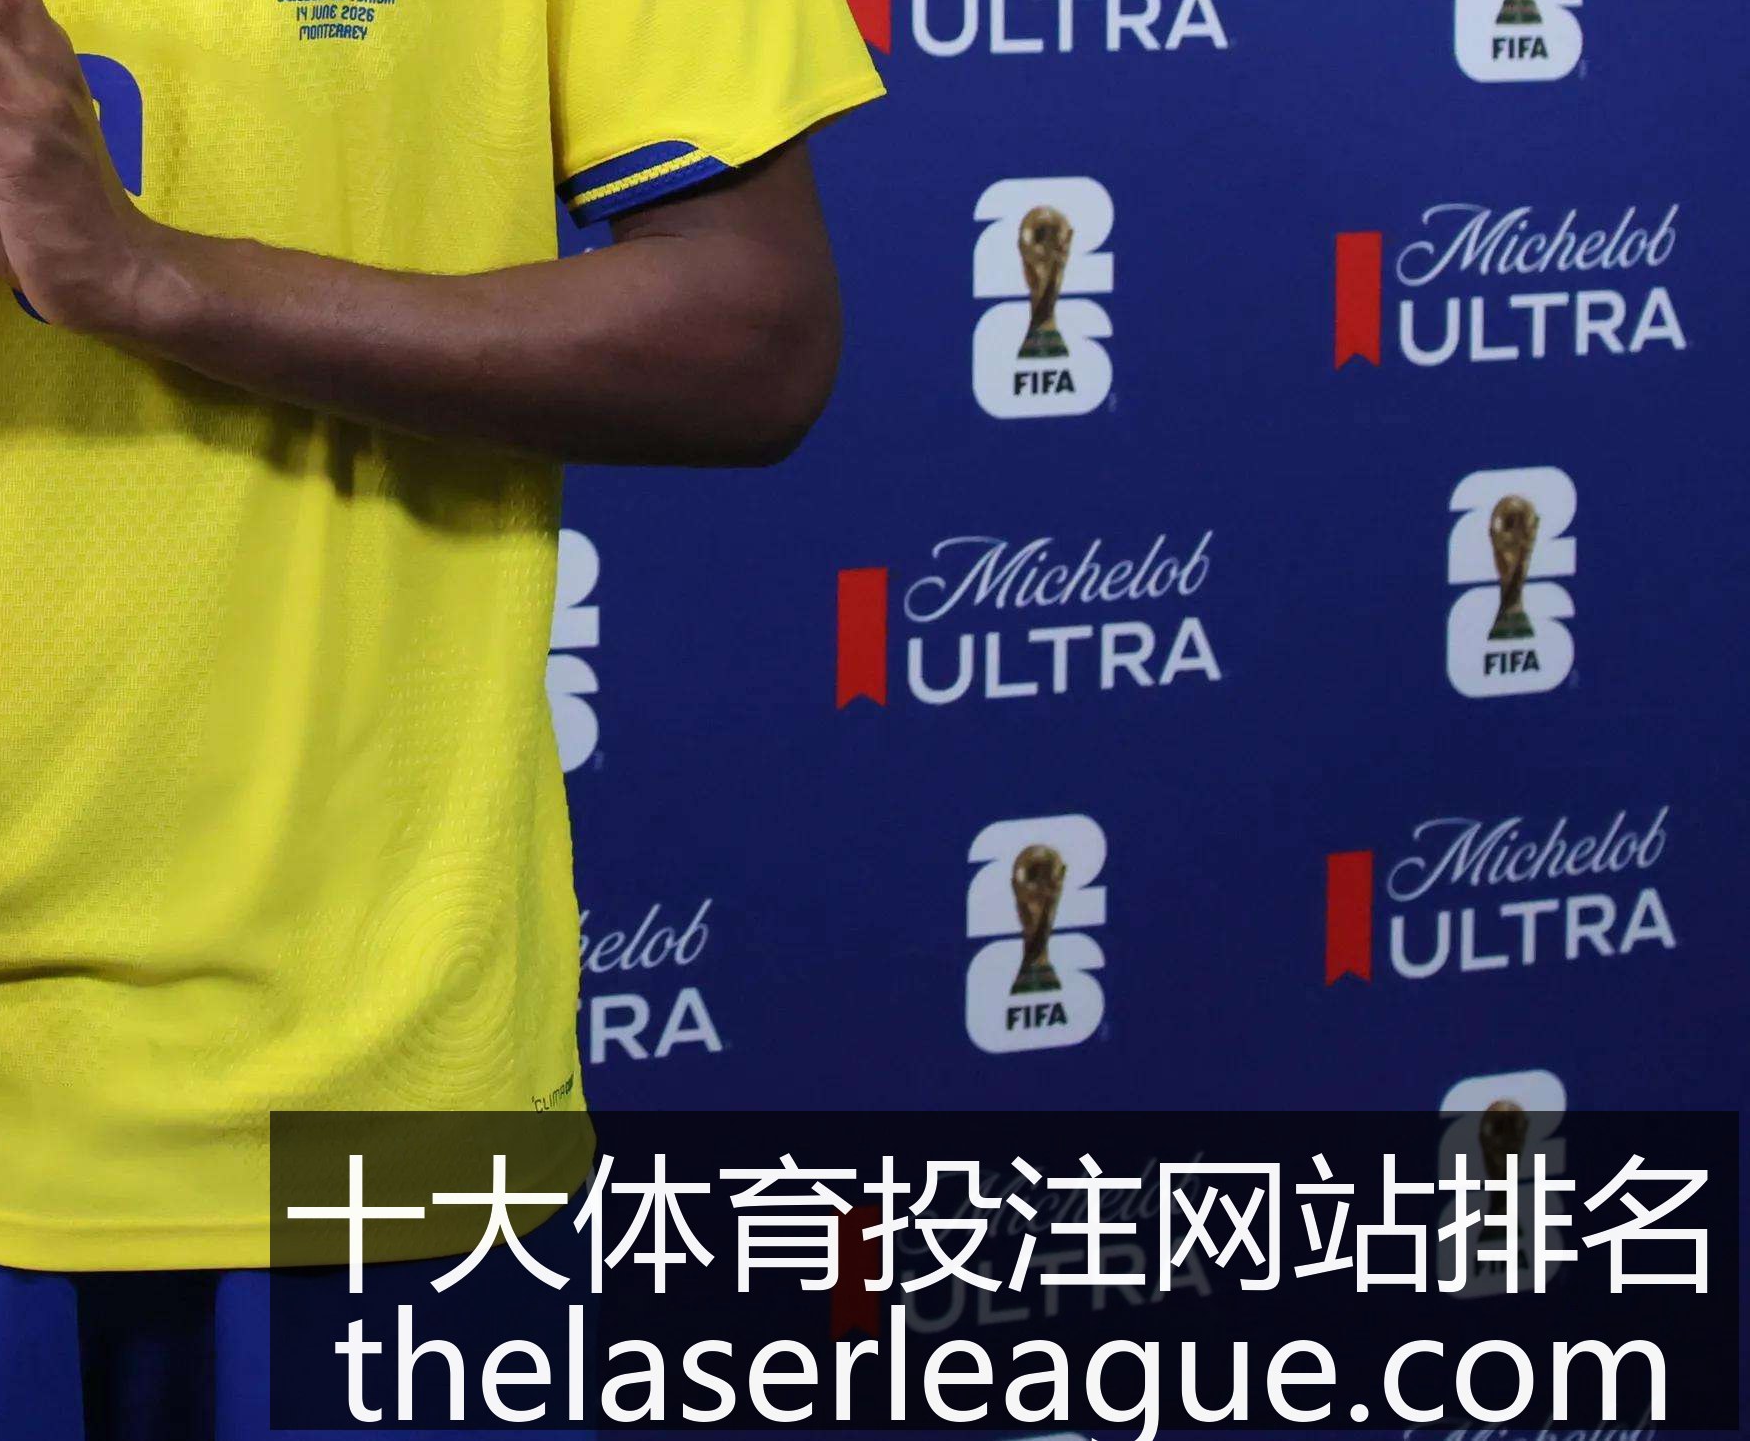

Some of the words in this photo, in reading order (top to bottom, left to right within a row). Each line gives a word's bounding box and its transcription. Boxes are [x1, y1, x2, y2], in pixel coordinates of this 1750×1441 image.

[296, 6, 308, 21] 14
[311, 4, 338, 20] JUNE
[341, 5, 375, 22] 2026
[299, 23, 368, 40] MONTERREY
[1493, 37, 1547, 59] FIFA
[1397, 204, 1678, 286] Michelob
[1400, 287, 1686, 366] ULTRA
[1014, 370, 1074, 395] FIFA
[904, 531, 1212, 622] Michelob
[908, 617, 1221, 705] ULTRA
[1484, 650, 1539, 675] FIFA
[1388, 806, 1668, 901] Michelob
[1388, 889, 1676, 979] ULTRA
[1007, 1003, 1067, 1030] FIFA
